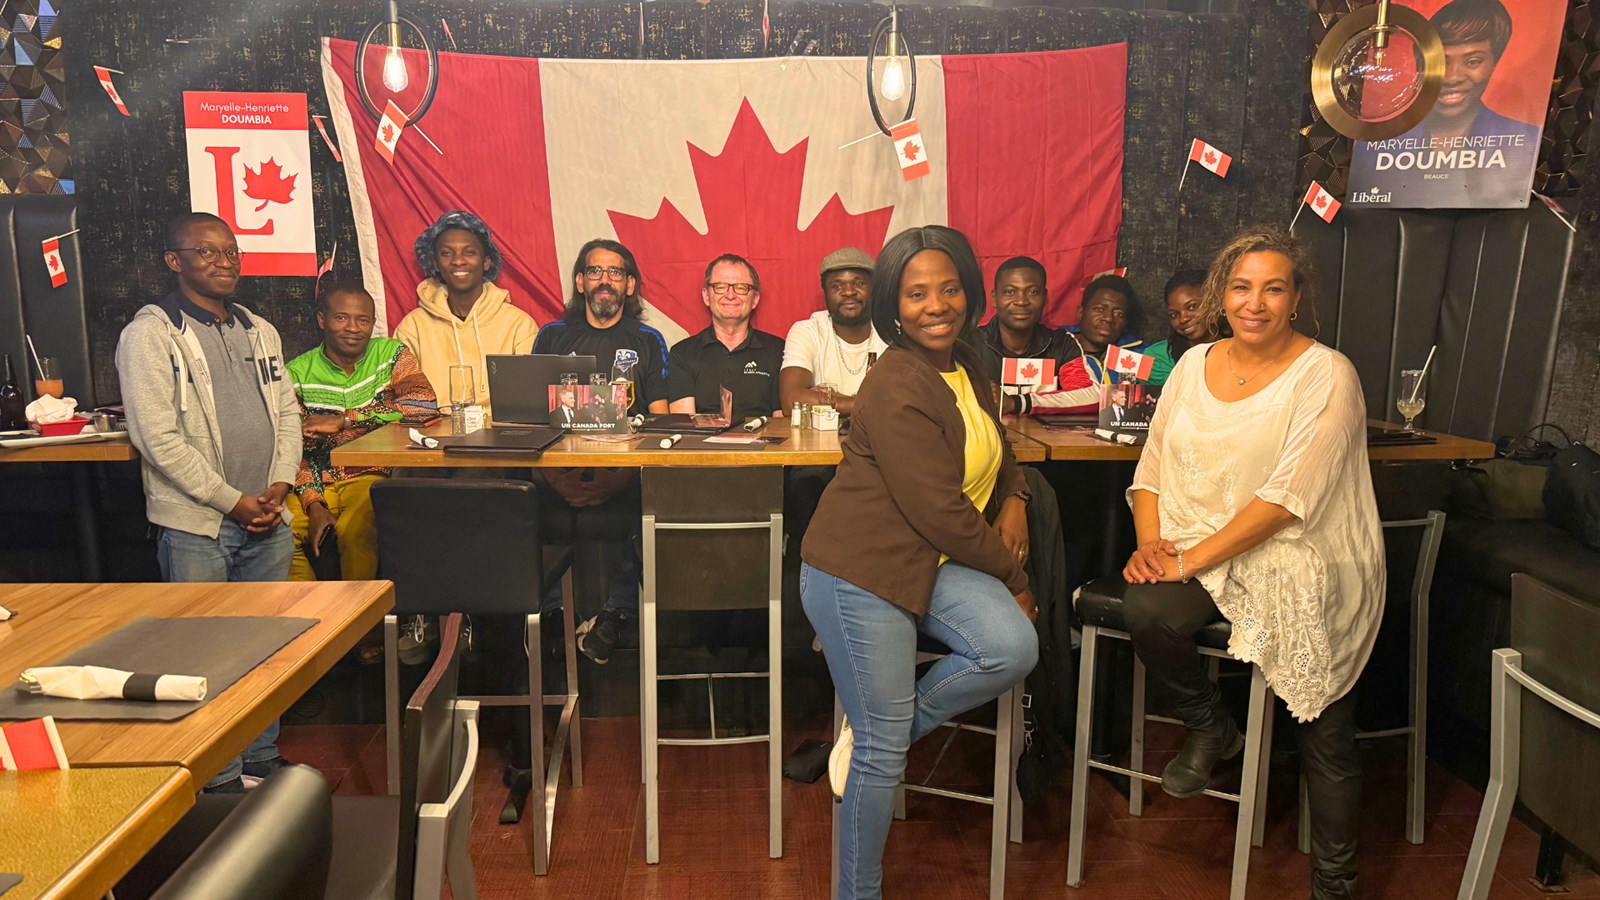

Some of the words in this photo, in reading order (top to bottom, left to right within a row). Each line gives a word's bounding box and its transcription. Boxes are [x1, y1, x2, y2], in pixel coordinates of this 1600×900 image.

[200, 102, 289, 114] Maryelle-Henriette
[221, 114, 272, 124] DOUMBIA
[1366, 135, 1525, 151] MARYELLE-HENRIETTE
[1375, 149, 1507, 171] DOUMBIA
